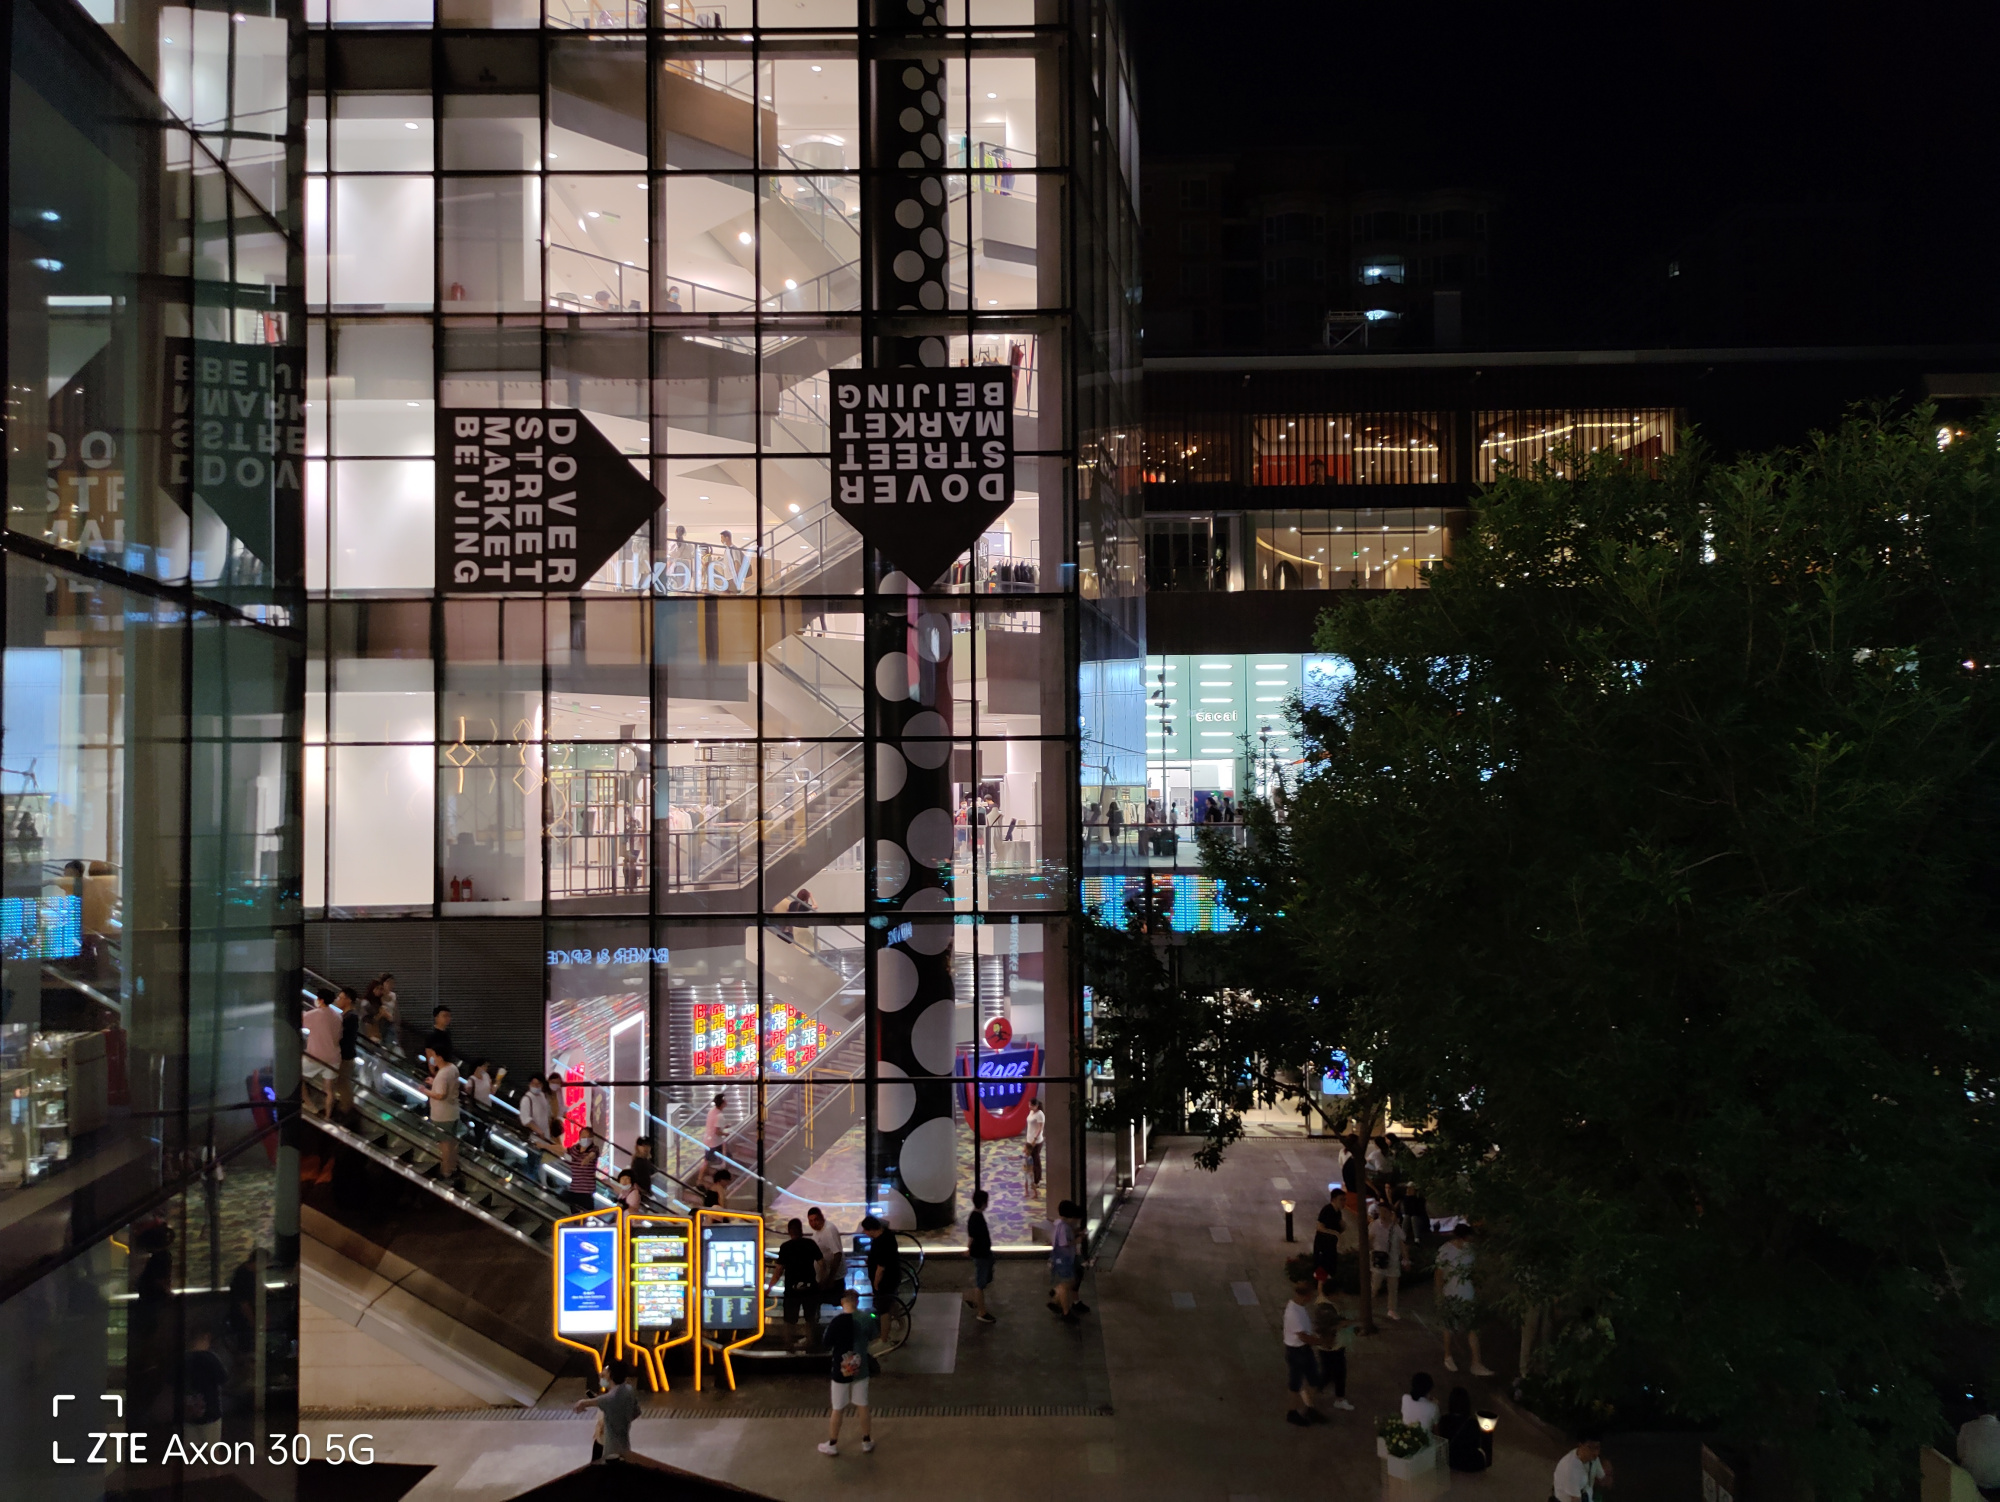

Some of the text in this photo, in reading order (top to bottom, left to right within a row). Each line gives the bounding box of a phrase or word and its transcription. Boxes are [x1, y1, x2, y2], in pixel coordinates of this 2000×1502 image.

[838, 382, 1004, 409] BEIJING
[839, 411, 1004, 439] MARKET
[839, 441, 1005, 470] STREET
[454, 417, 479, 583] BEIJING
[484, 417, 510, 583] MARKET
[515, 417, 543, 583] STREET
[548, 419, 577, 583] DOVER
[839, 473, 1004, 504] DOVER
[1196, 710, 1238, 722] sacai
[979, 1060, 1029, 1079] BAPE
[979, 1083, 1022, 1097] STORE
